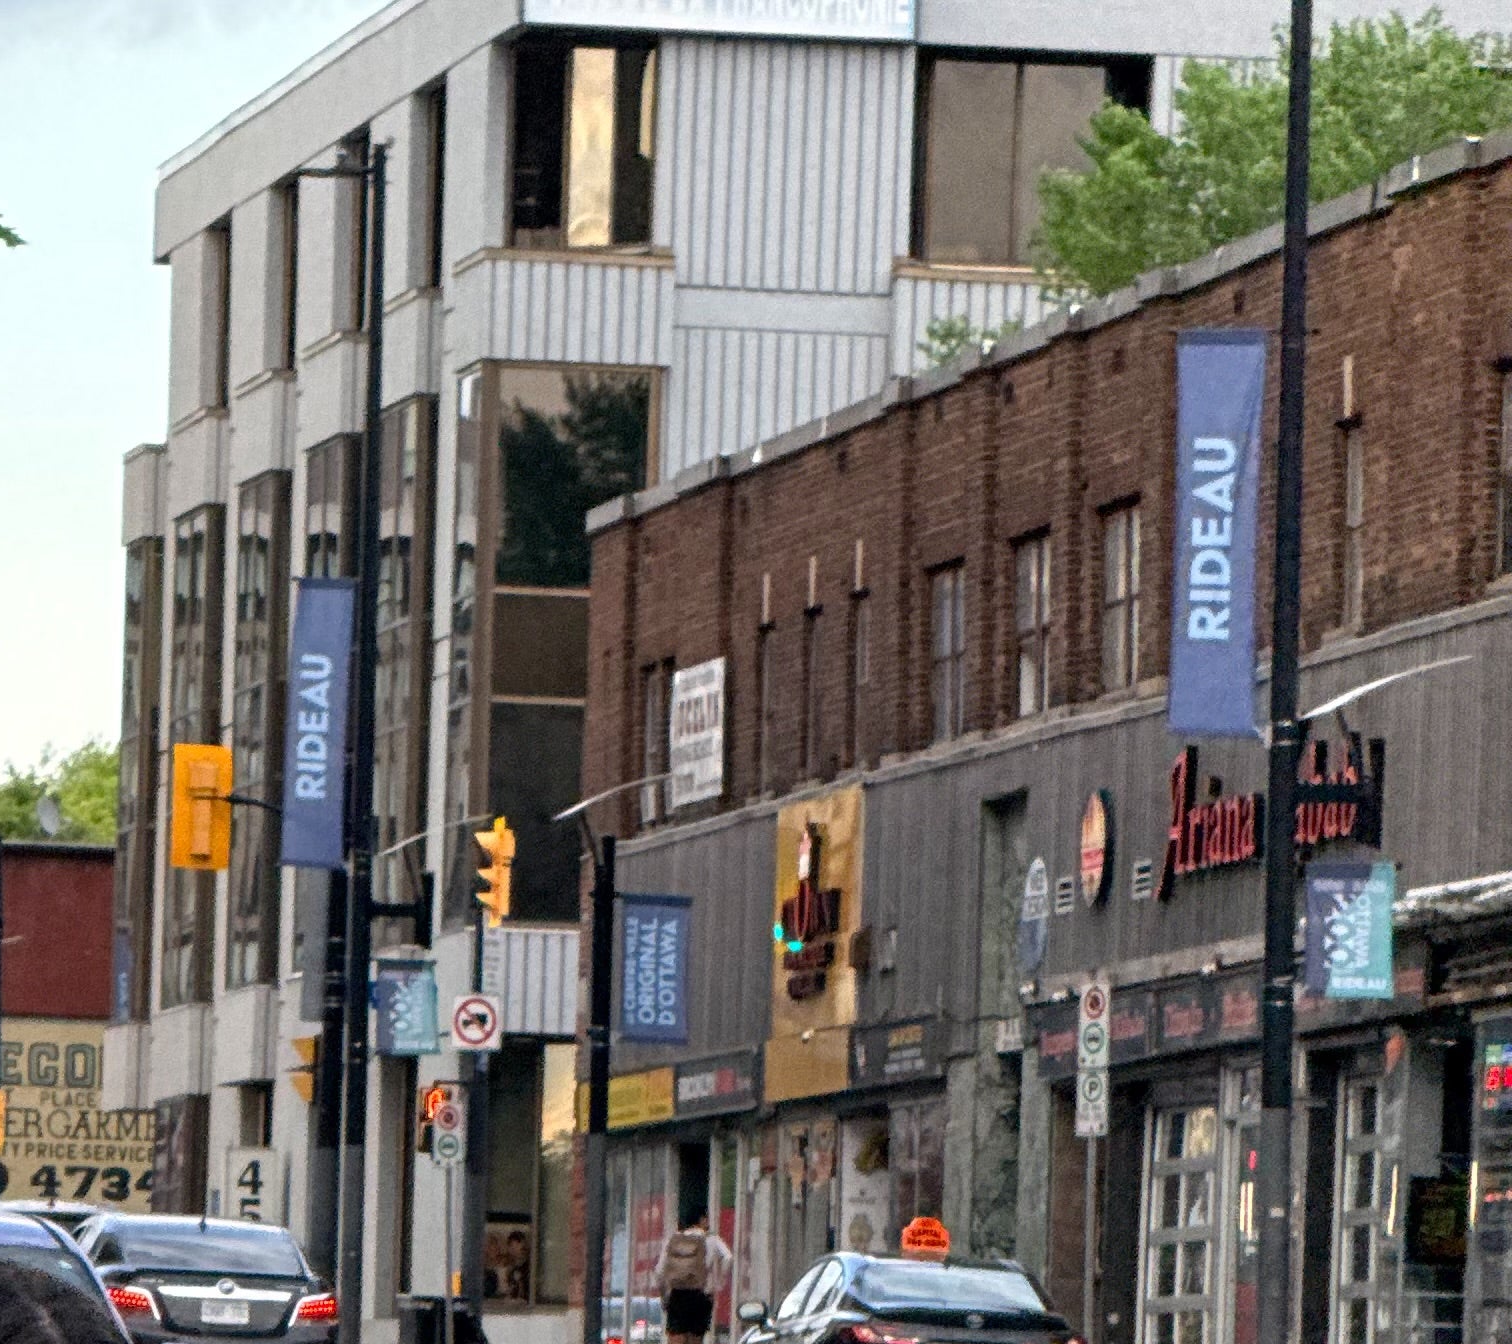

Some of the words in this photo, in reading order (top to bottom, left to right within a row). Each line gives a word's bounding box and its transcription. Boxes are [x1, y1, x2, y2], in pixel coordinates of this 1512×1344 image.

[1187, 437, 1238, 641] RIDEAU
[294, 653, 334, 800] RIDEAU
[638, 917, 658, 1024] ORIGINAL
[658, 919, 678, 1026] D'OTTAWA
[24, 1141, 78, 1160] PRICE
[40, 1090, 97, 1108] PLACE
